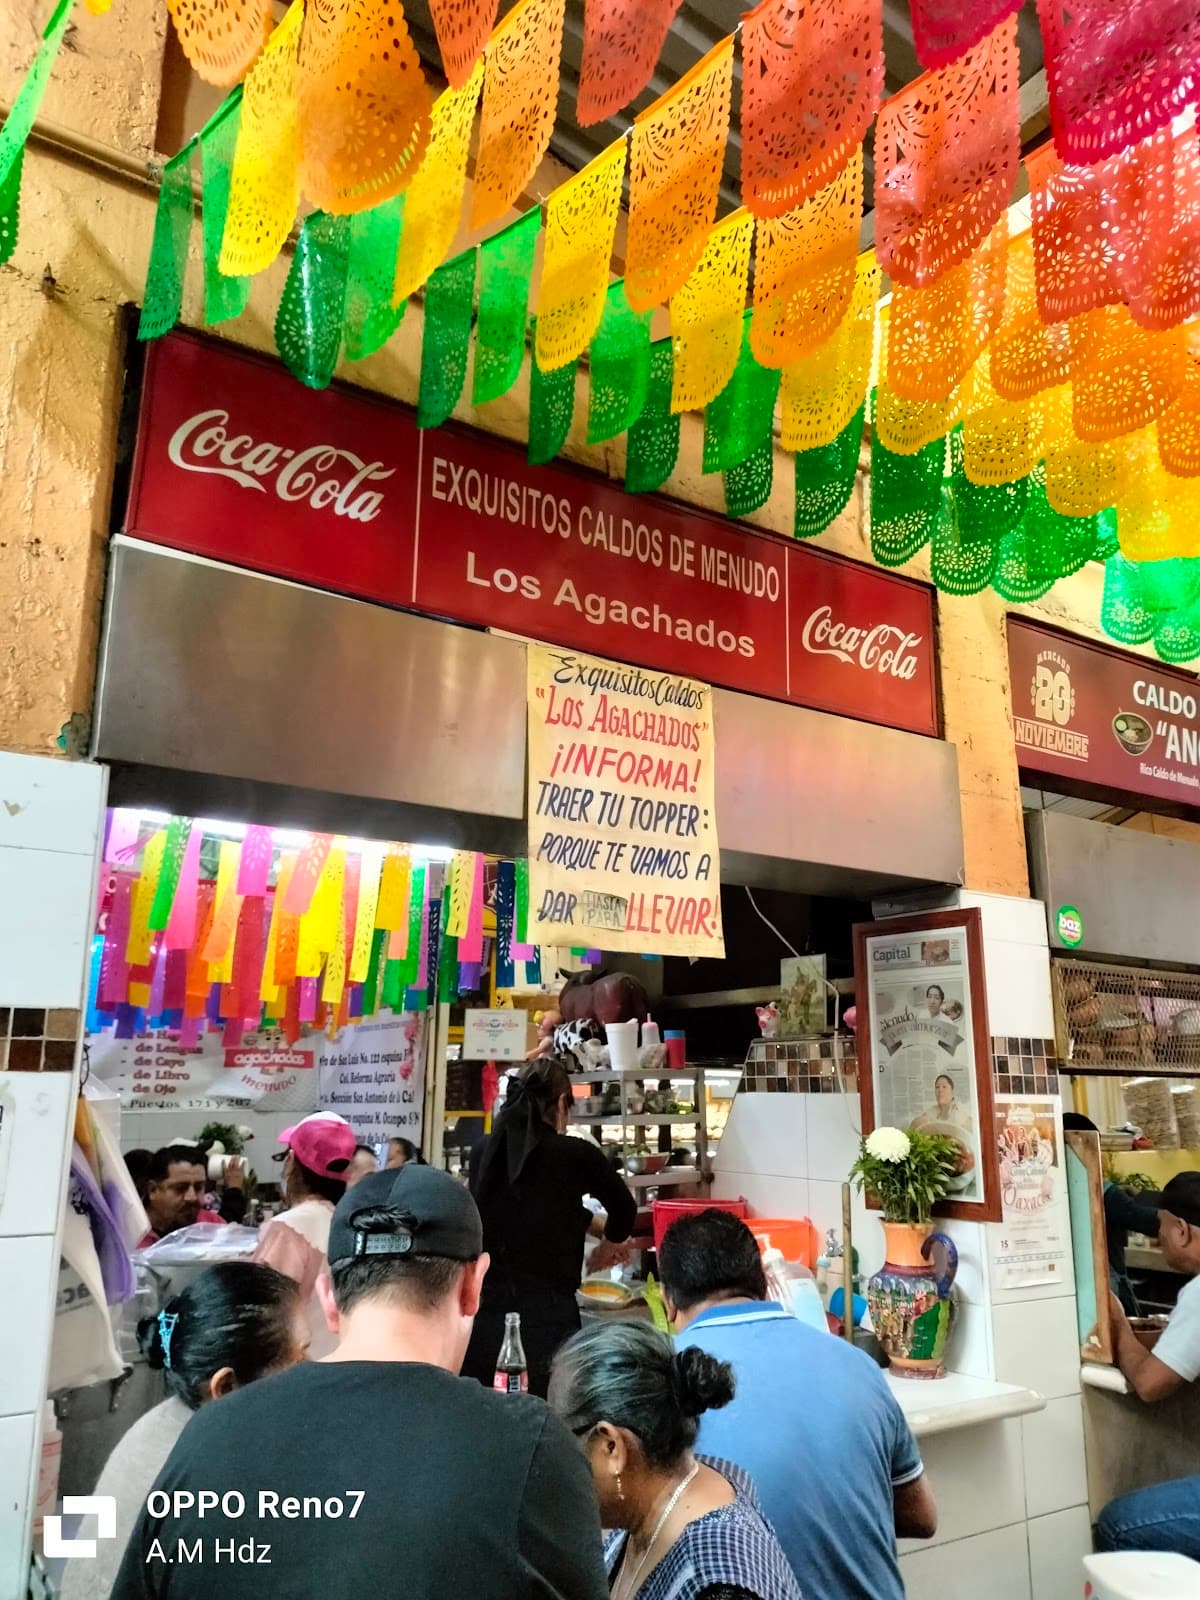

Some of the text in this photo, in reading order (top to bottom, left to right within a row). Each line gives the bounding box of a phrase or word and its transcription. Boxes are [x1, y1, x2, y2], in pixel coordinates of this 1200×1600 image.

[168, 409, 397, 523] Coca-Cola
[432, 456, 780, 603] EXQUISITOS CALDOS DE MENUDO
[466, 551, 756, 658] Los Agachados
[801, 605, 924, 681] Coca-Cola
[1036, 650, 1071, 674] MERCADO
[548, 653, 704, 711] Exquisitos Caldos
[1034, 664, 1071, 726] 20
[1133, 680, 1197, 719] CALDO
[1015, 719, 1089, 759] NOVIEMBRE
[550, 743, 702, 793] ¡INFORMA!
[1153, 766, 1169, 780] Caldo
[535, 781, 709, 837] TRAER TU TOPPER:
[536, 832, 712, 881] PORQUE TE VAMOS A
[538, 889, 719, 939] DAR LLEVAR!
[872, 946, 911, 963] Capital
[134, 1056, 185, 1069] de Cayo
[136, 1043, 153, 1053] de
[132, 1083, 176, 1095] de Ojo
[133, 1070, 190, 1081] de Libro
